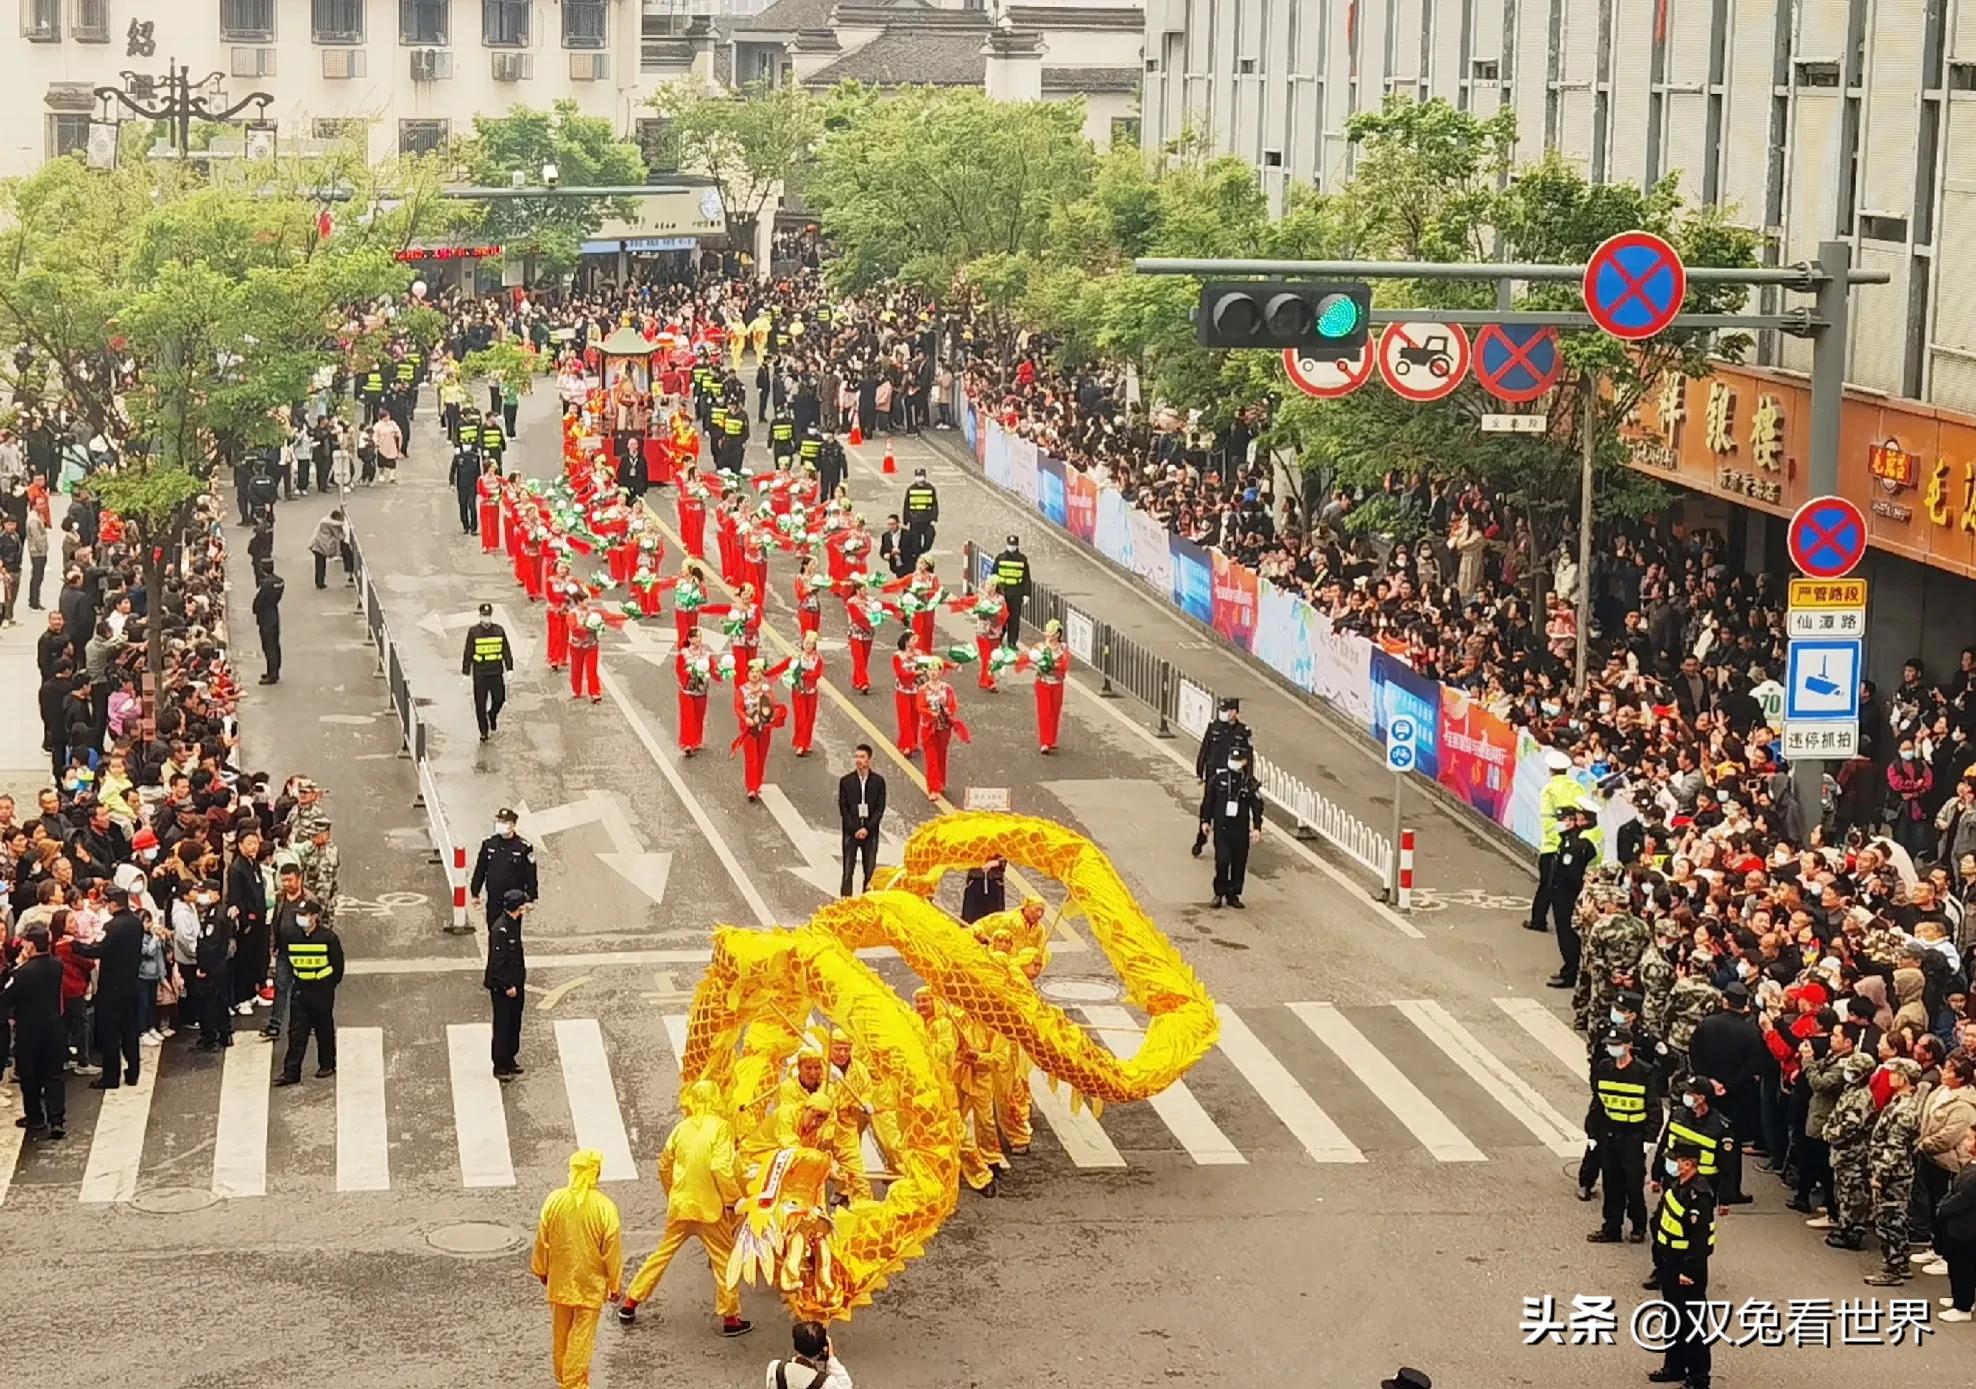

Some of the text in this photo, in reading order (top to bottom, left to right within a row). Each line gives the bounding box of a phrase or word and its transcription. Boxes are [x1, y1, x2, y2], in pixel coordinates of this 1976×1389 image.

[1797, 586, 1859, 602] 严管路段
[1797, 614, 1857, 630] 仙潭路
[1760, 694, 1781, 714] 70
[1788, 731, 1852, 750] 违停抓拍
